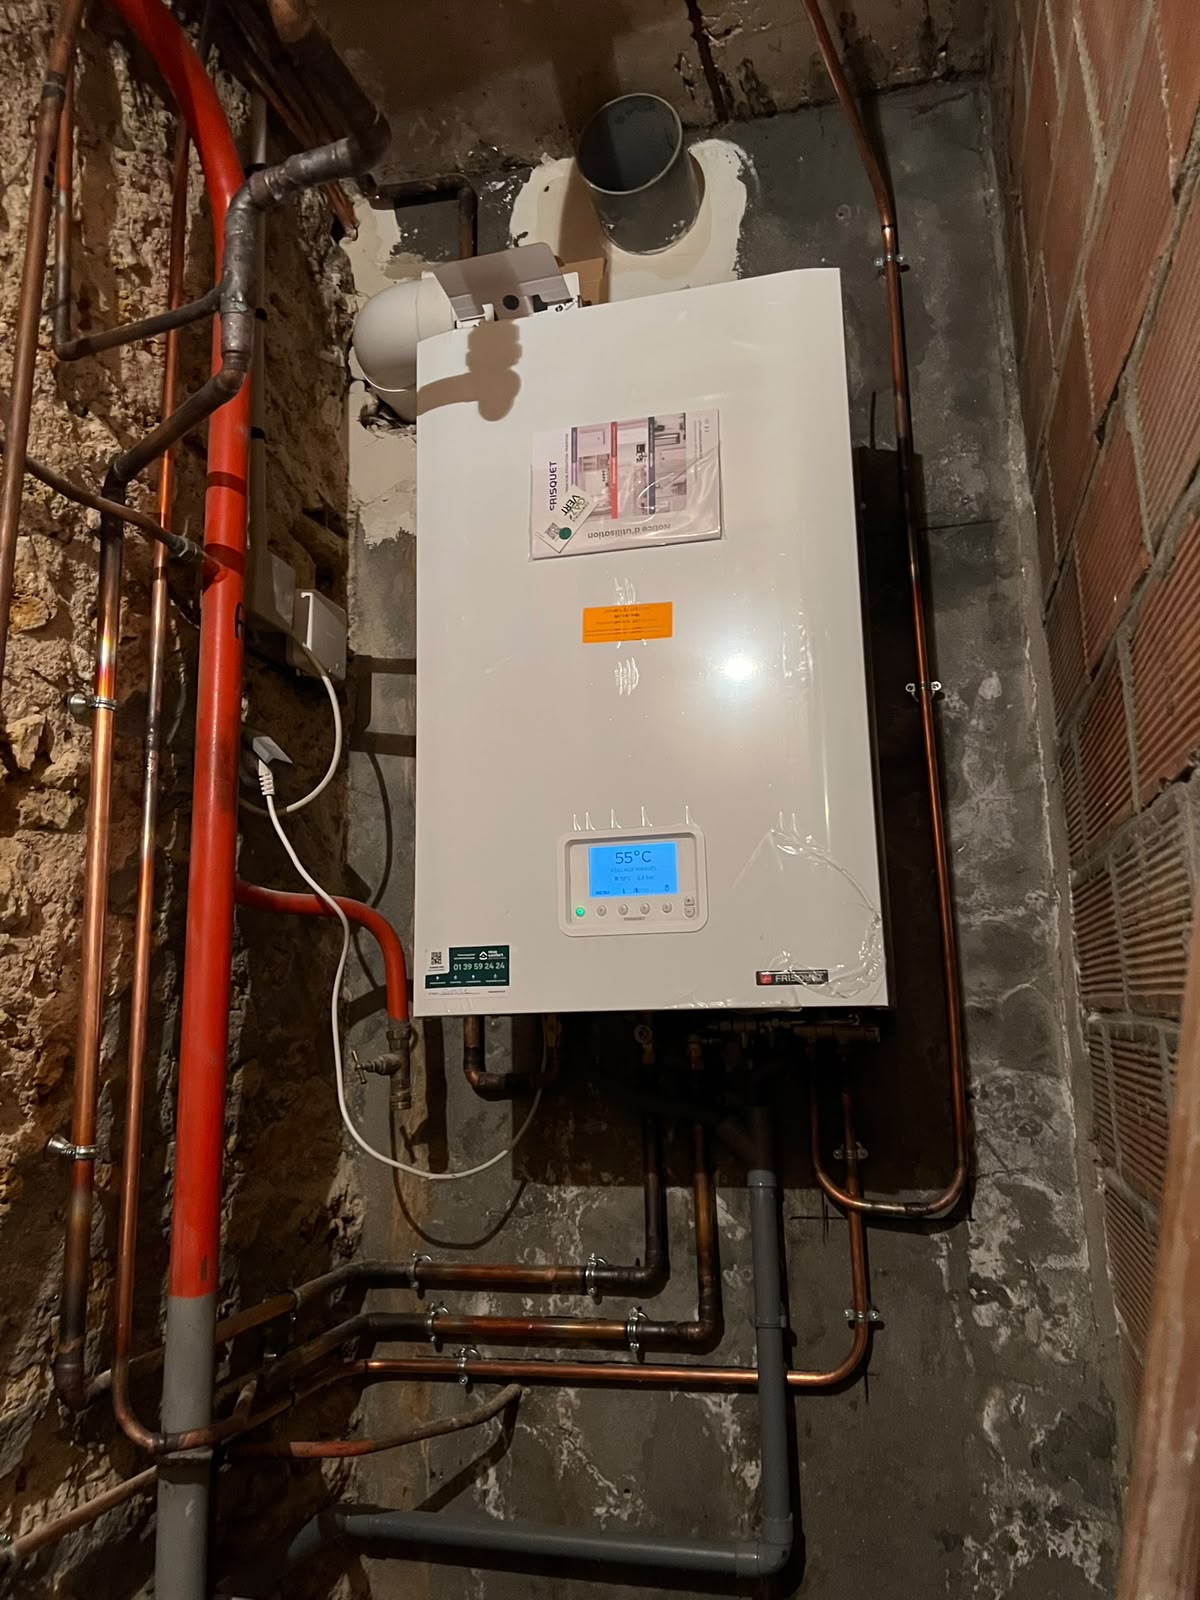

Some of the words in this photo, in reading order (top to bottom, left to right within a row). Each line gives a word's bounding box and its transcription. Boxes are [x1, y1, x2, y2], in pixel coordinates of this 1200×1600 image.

[549, 461, 557, 511] FRISQUET
[560, 494, 581, 516] VERT
[587, 527, 641, 540] d'utilisation
[642, 523, 671, 532] Notice
[615, 850, 652, 864] 55°C
[453, 963, 462, 971] 01
[474, 962, 484, 970] 59
[484, 962, 494, 970] 24
